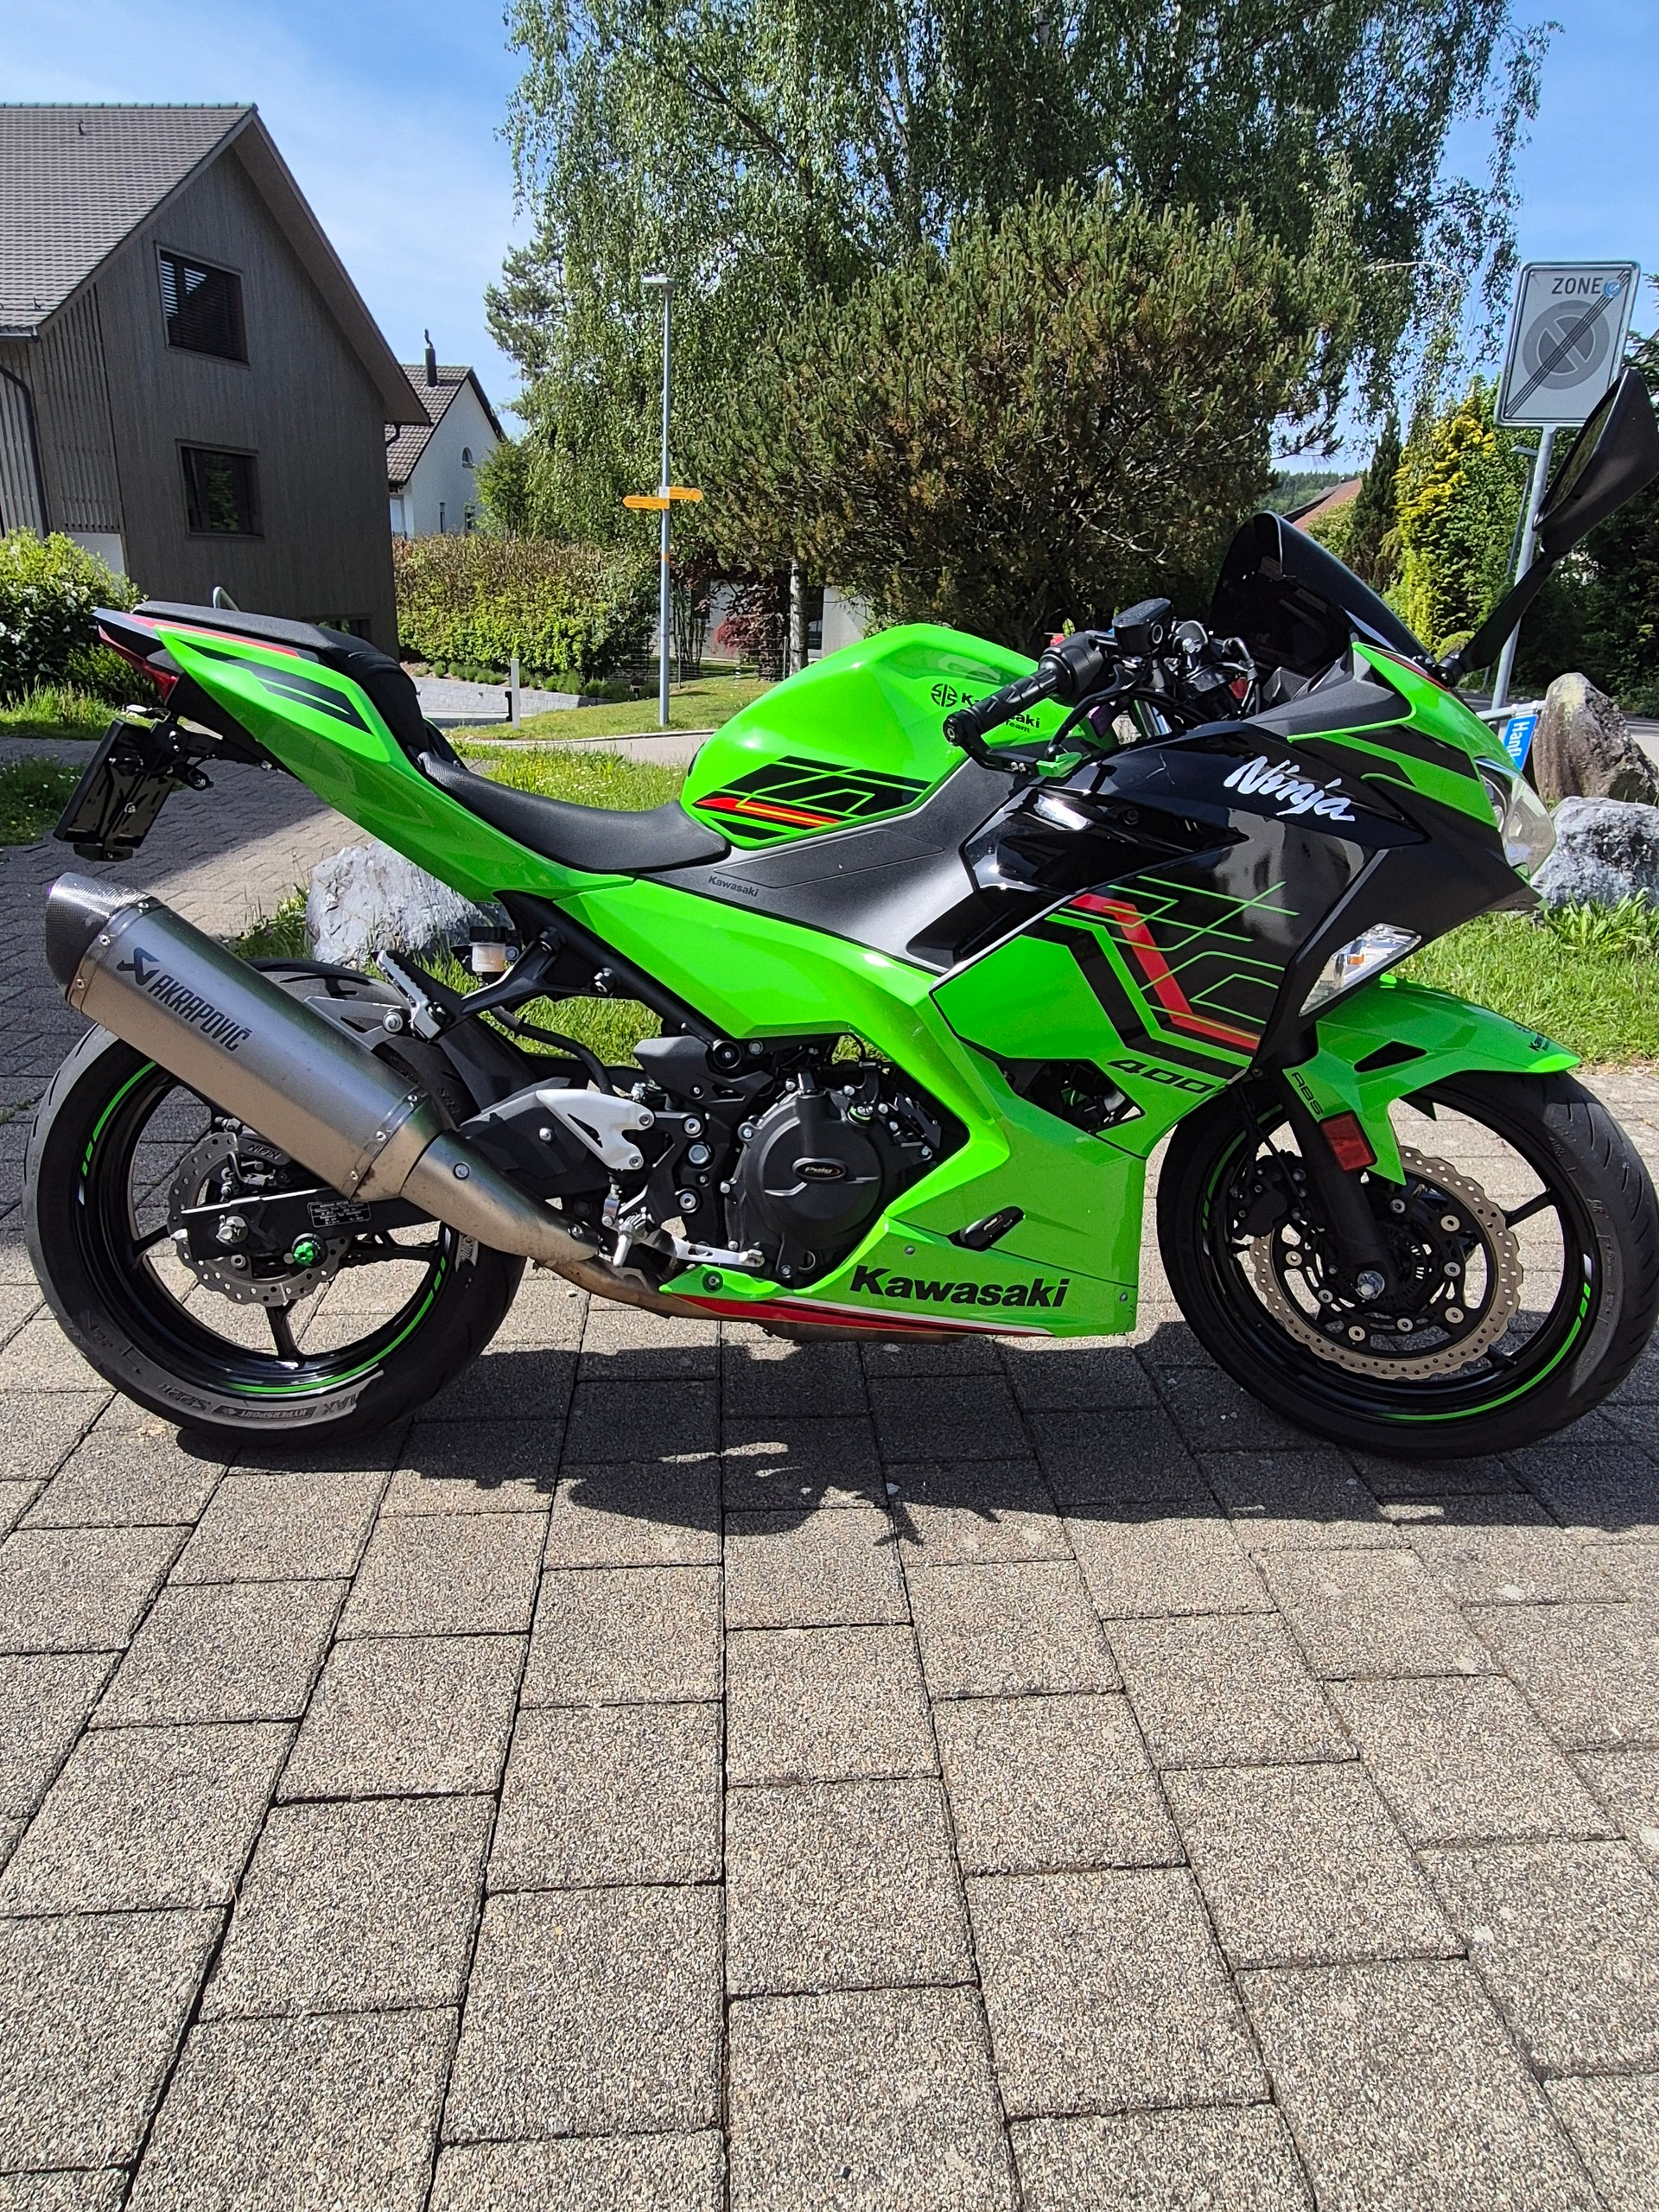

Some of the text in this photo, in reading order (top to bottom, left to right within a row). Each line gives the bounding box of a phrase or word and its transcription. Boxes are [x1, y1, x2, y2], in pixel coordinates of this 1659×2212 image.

[1552, 277, 1604, 295] ZONE
[1223, 755, 1356, 822] Ninja
[708, 875, 760, 897] Kawasaki
[147, 974, 252, 1052] AKRAPOVIČ
[1107, 1059, 1216, 1094] 400
[1291, 1071, 1324, 1115] ABS
[849, 1264, 1070, 1307] Kawasaki
